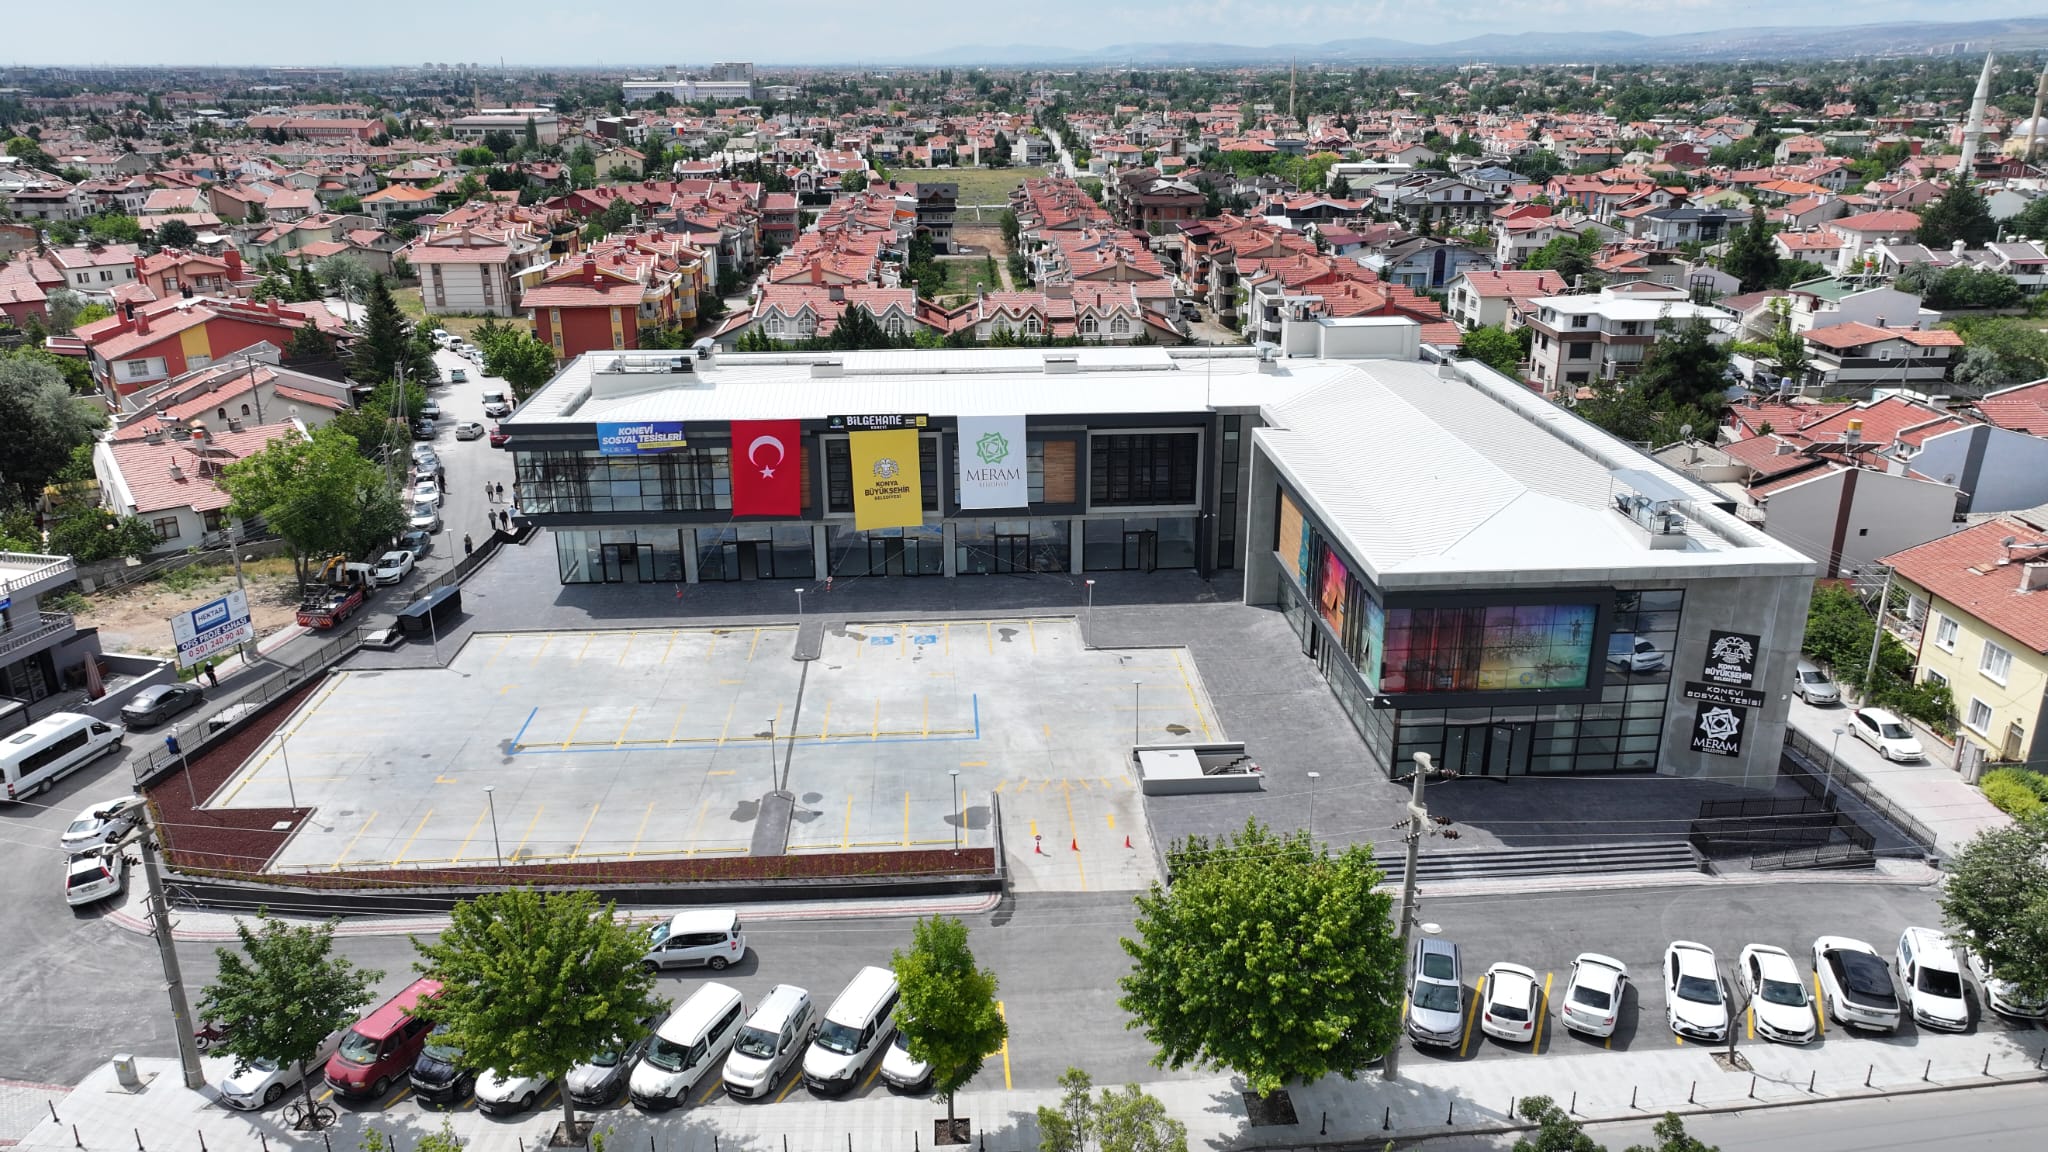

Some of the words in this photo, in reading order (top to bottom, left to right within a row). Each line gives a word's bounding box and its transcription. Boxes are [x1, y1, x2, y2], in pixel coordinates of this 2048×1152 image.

[618, 424, 653, 435] KONEVİ
[603, 435, 638, 445] SOSYAL
[639, 430, 682, 443] TESİSLERİ
[967, 468, 1020, 481] MERAM
[198, 607, 224, 621] HEKTAR
[199, 629, 222, 643] PROJE
[222, 617, 247, 633] SAHASI
[195, 644, 208, 655] 501
[211, 637, 224, 648] 240
[225, 632, 234, 642] 90
[236, 627, 245, 637] 40
[1718, 663, 1742, 671] KONYA
[1687, 691, 1725, 702] SOSYAL
[1707, 686, 1744, 696] KONEVİ
[1693, 737, 1738, 752] MERAM
